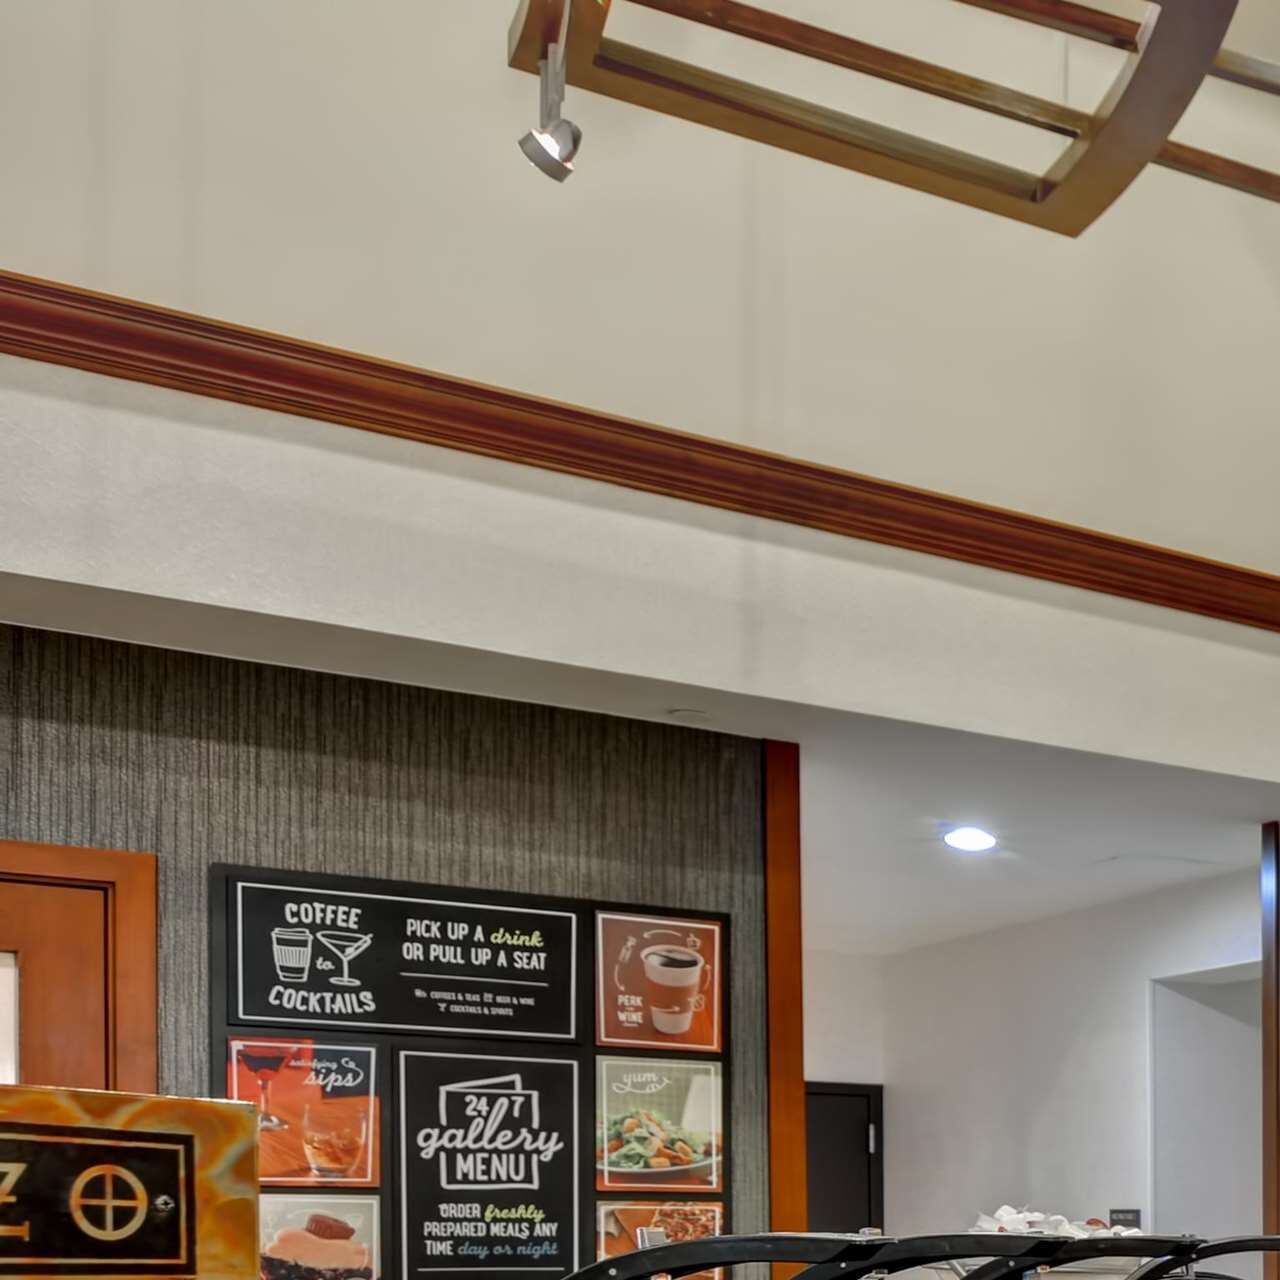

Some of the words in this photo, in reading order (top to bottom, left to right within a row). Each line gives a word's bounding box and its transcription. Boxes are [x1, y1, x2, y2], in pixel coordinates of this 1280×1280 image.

[285, 902, 361, 930] COFFEE
[406, 918, 441, 939] PICK
[447, 922, 469, 940] UP
[473, 925, 485, 943] A
[490, 928, 544, 947] drink
[316, 957, 335, 970] to
[402, 942, 424, 962] OR
[429, 944, 465, 965] PULL
[470, 947, 492, 966] UP
[496, 950, 508, 968] A
[513, 951, 547, 970] SEAT
[268, 985, 376, 1015] COCKTAILS
[617, 994, 644, 1008] PERK
[617, 1011, 644, 1024] WINE
[304, 1064, 363, 1093] sips
[612, 1072, 664, 1093] yum
[464, 1094, 489, 1117] 24
[416, 1097, 564, 1162] gallery
[456, 1152, 525, 1181] MENU
[438, 1203, 481, 1219] ORDER
[484, 1204, 545, 1222] freshly
[423, 1221, 487, 1237] PREPARED
[490, 1222, 529, 1239] MEALS
[533, 1222, 558, 1237] ANY
[424, 1240, 454, 1256] TIME
[457, 1241, 490, 1259] day
[493, 1246, 513, 1255] or
[516, 1241, 559, 1259] night
